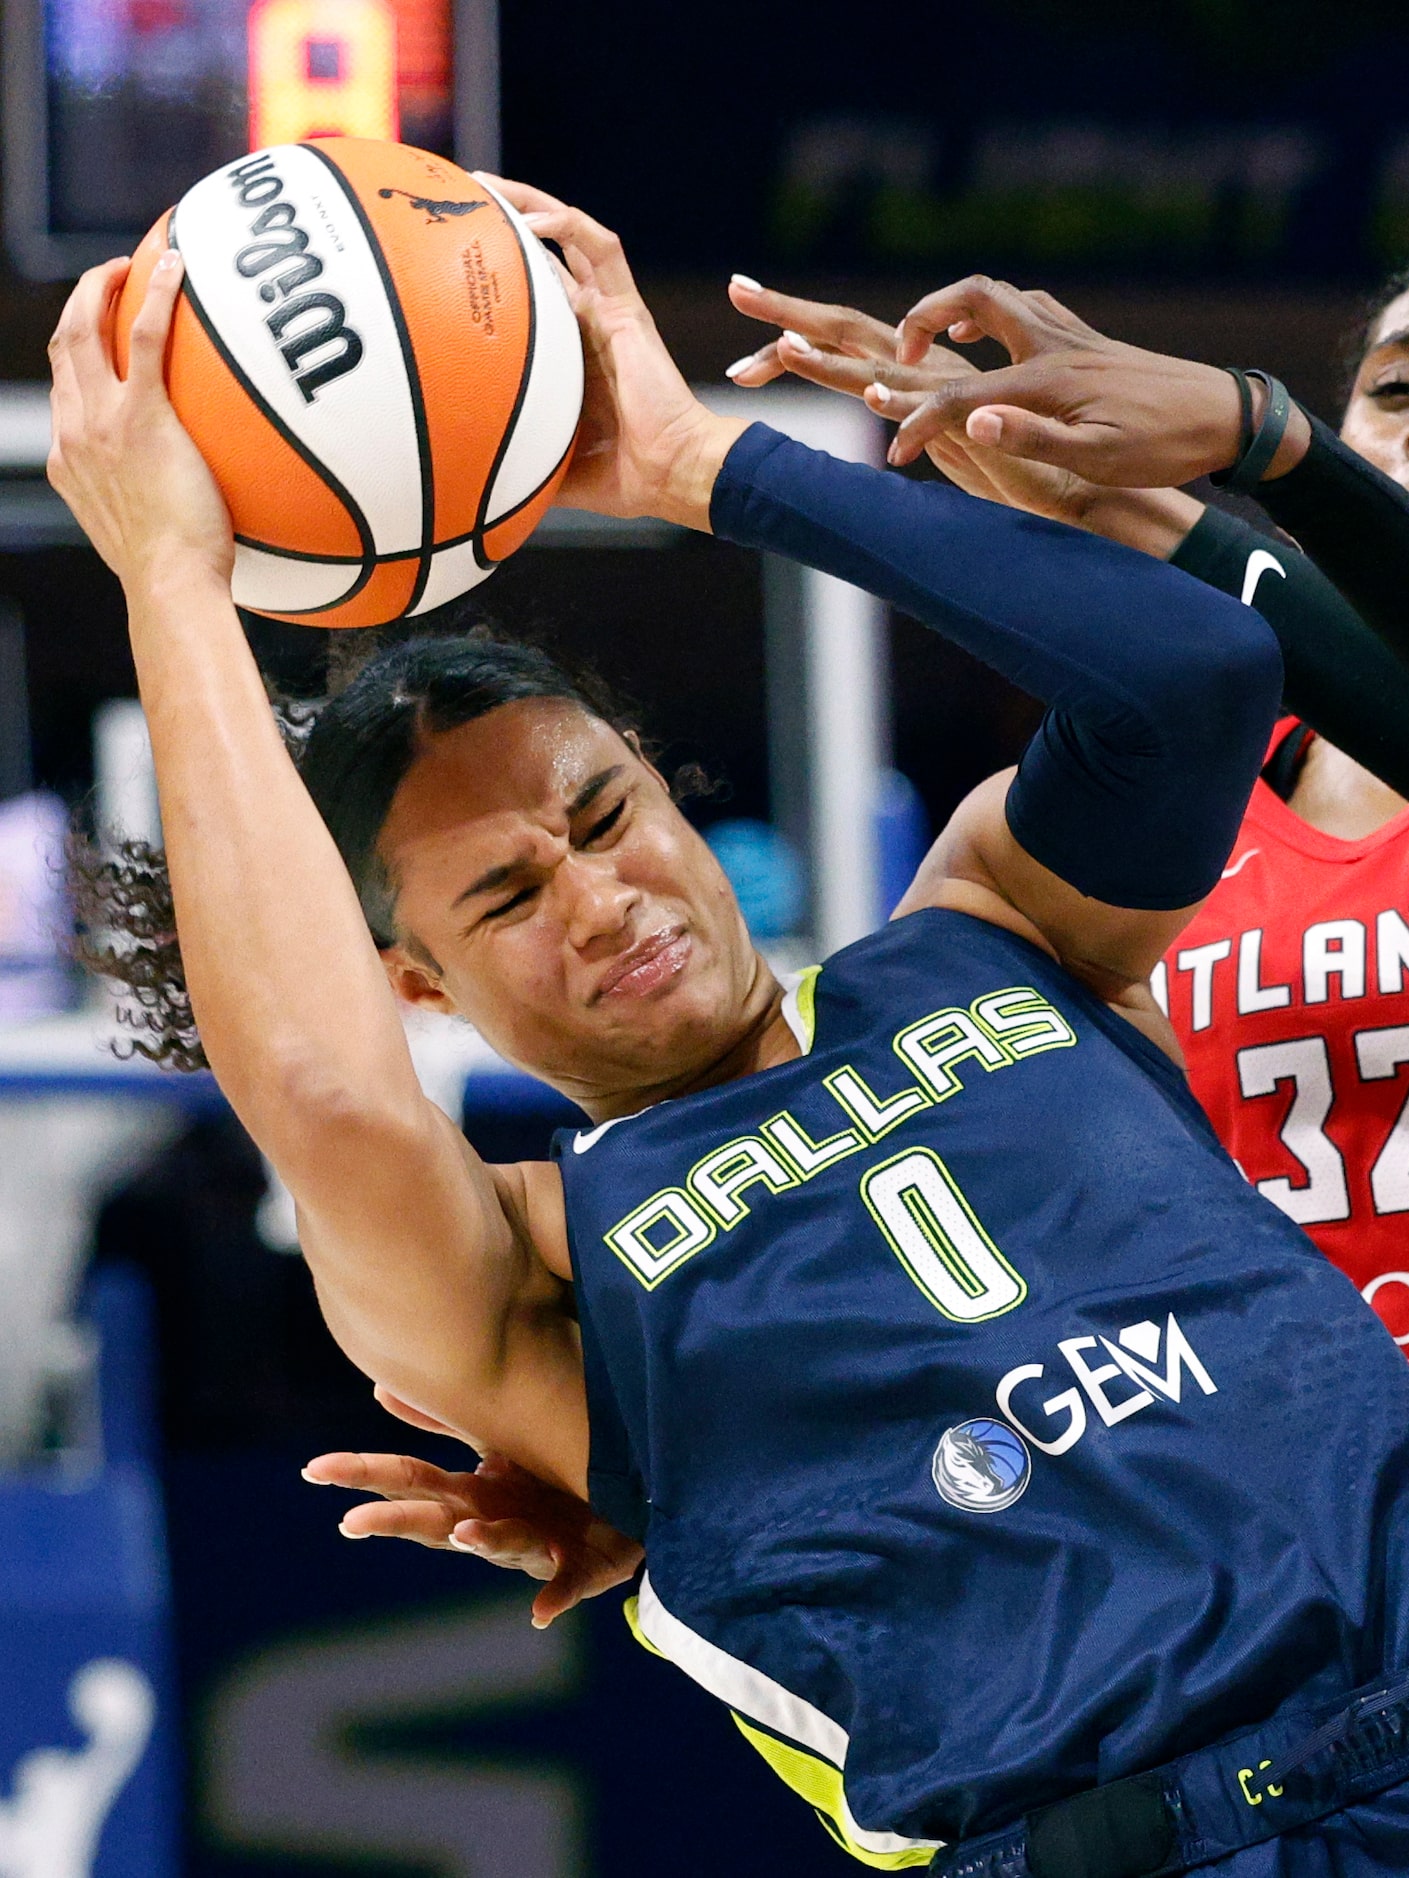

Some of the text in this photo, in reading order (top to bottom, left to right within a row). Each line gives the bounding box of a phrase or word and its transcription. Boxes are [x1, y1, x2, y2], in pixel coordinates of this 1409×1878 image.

[227, 153, 366, 407] Wilson
[603, 986, 1077, 1292] DALLAS
[859, 1146, 1028, 1323] 0
[995, 1311, 1219, 1456] GEM
